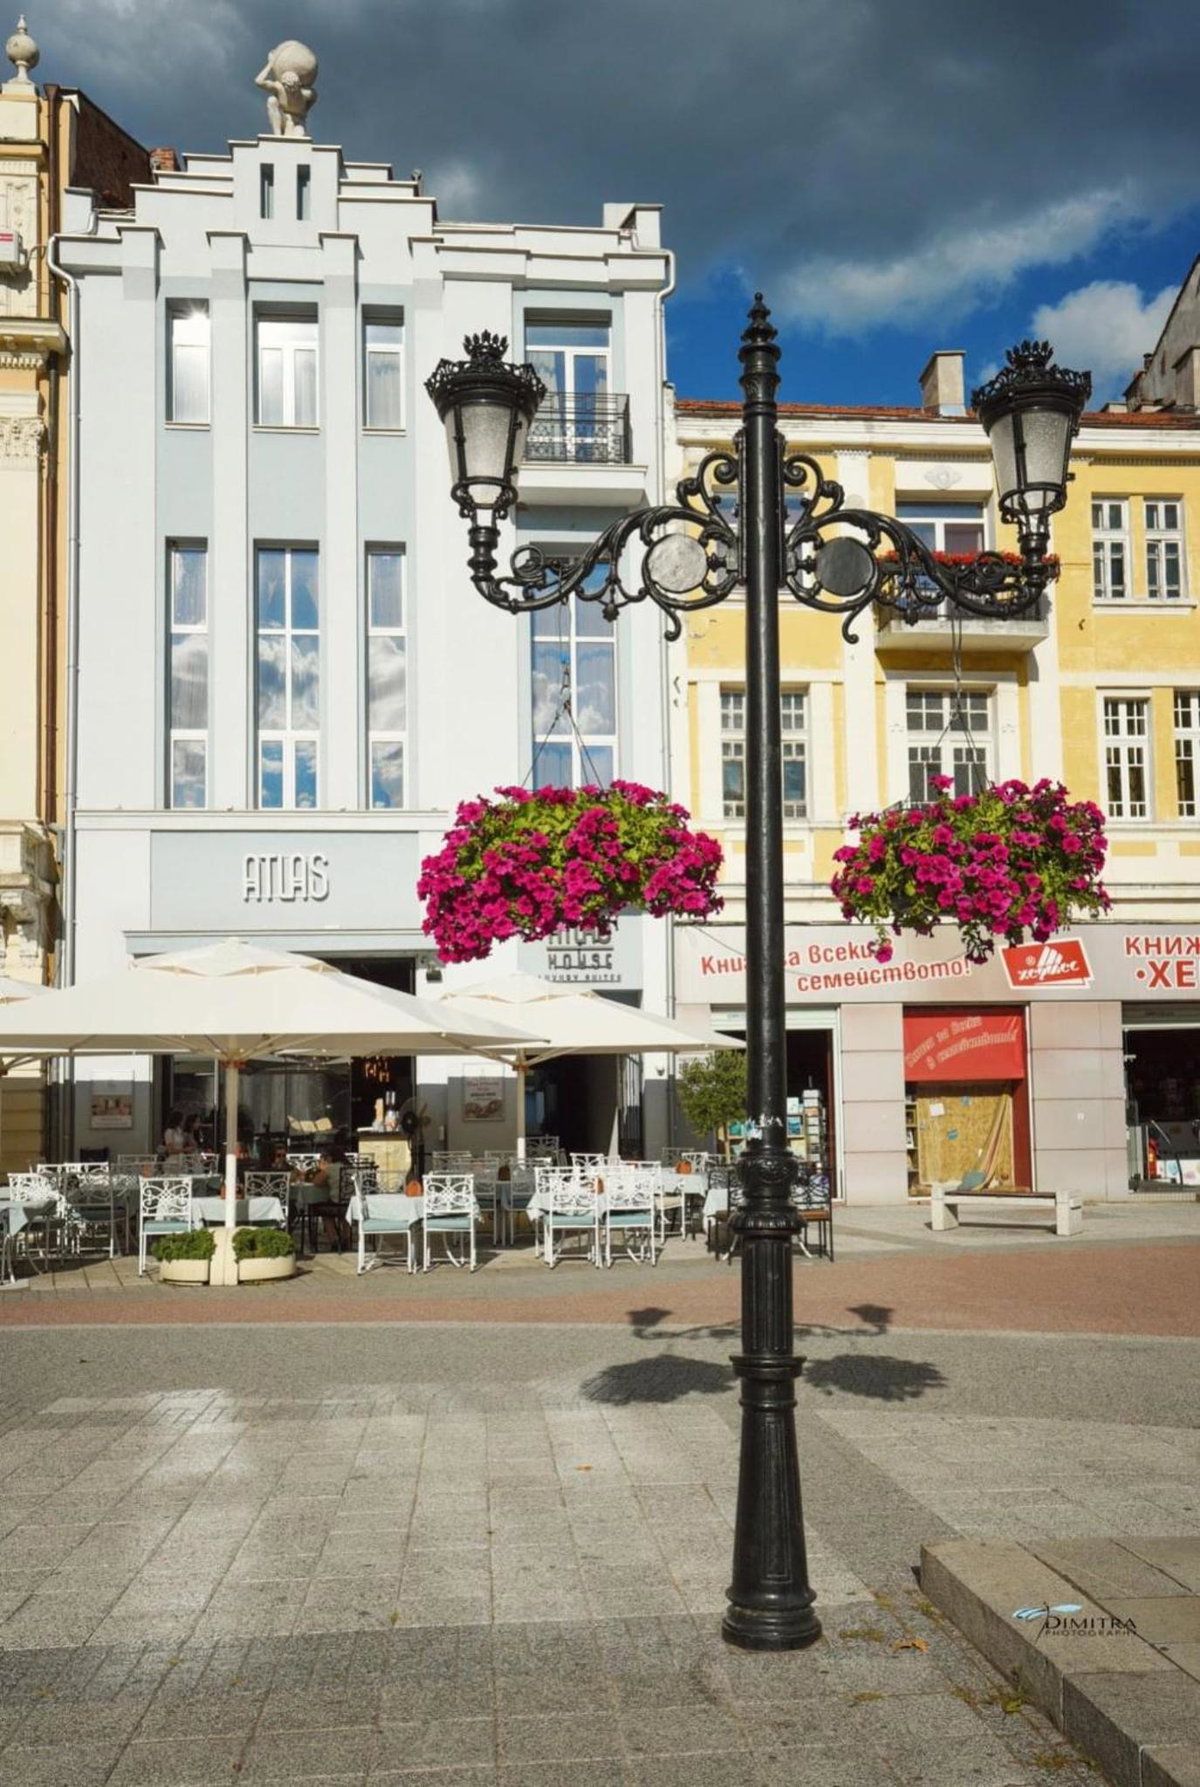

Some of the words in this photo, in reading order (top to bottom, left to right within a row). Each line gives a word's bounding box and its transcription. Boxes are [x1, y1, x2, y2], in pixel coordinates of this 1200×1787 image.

[243, 853, 329, 903] ATLAS
[548, 953, 613, 970] HOUSE
[701, 953, 748, 975] Кни
[797, 957, 971, 992] семейството!
